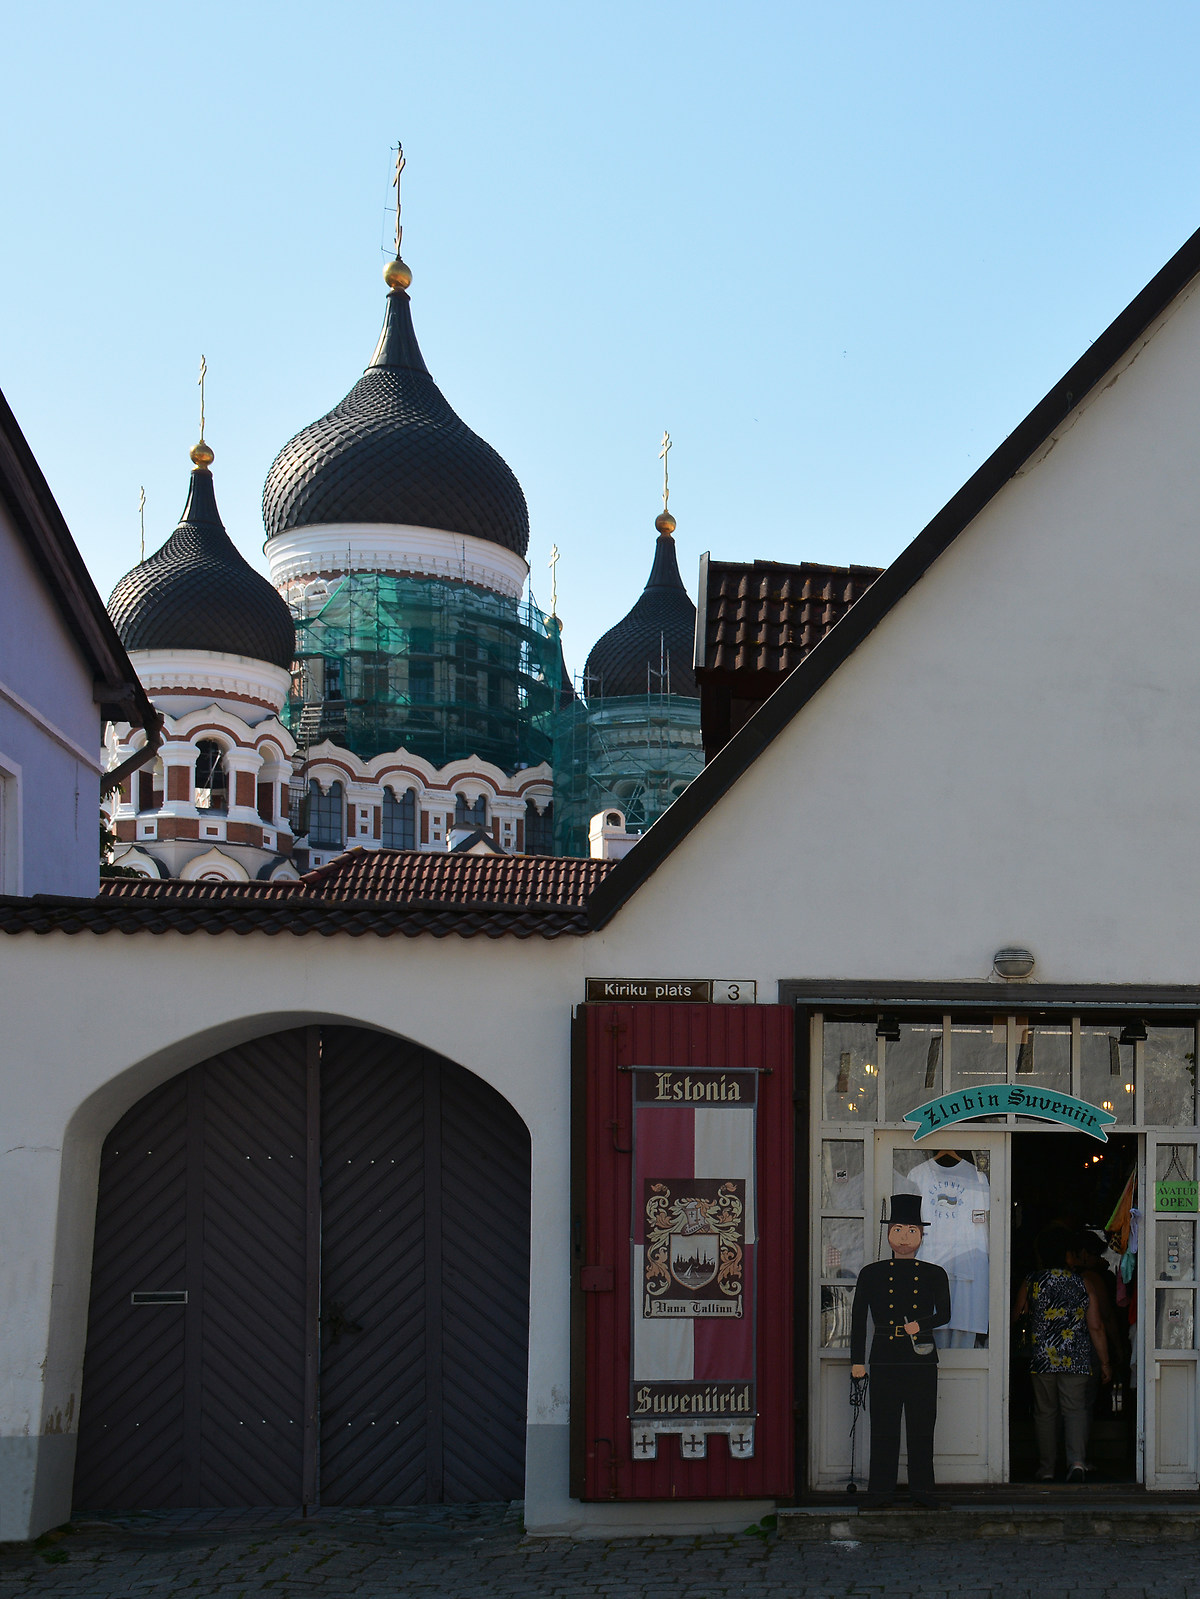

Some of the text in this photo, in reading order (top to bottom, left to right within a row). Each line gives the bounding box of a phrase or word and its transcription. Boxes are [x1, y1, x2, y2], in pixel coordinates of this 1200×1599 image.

[604, 983, 692, 999] Kiriku plats
[727, 984, 740, 1001] 3
[654, 1072, 741, 1101] Estonia
[923, 1088, 1098, 1127] Zlobin Suveniir
[1157, 1187, 1197, 1195] AVATUD
[1160, 1197, 1194, 1207] OPEN
[655, 1301, 732, 1315] Vana Tallinn
[634, 1384, 751, 1414] Suveniirid
